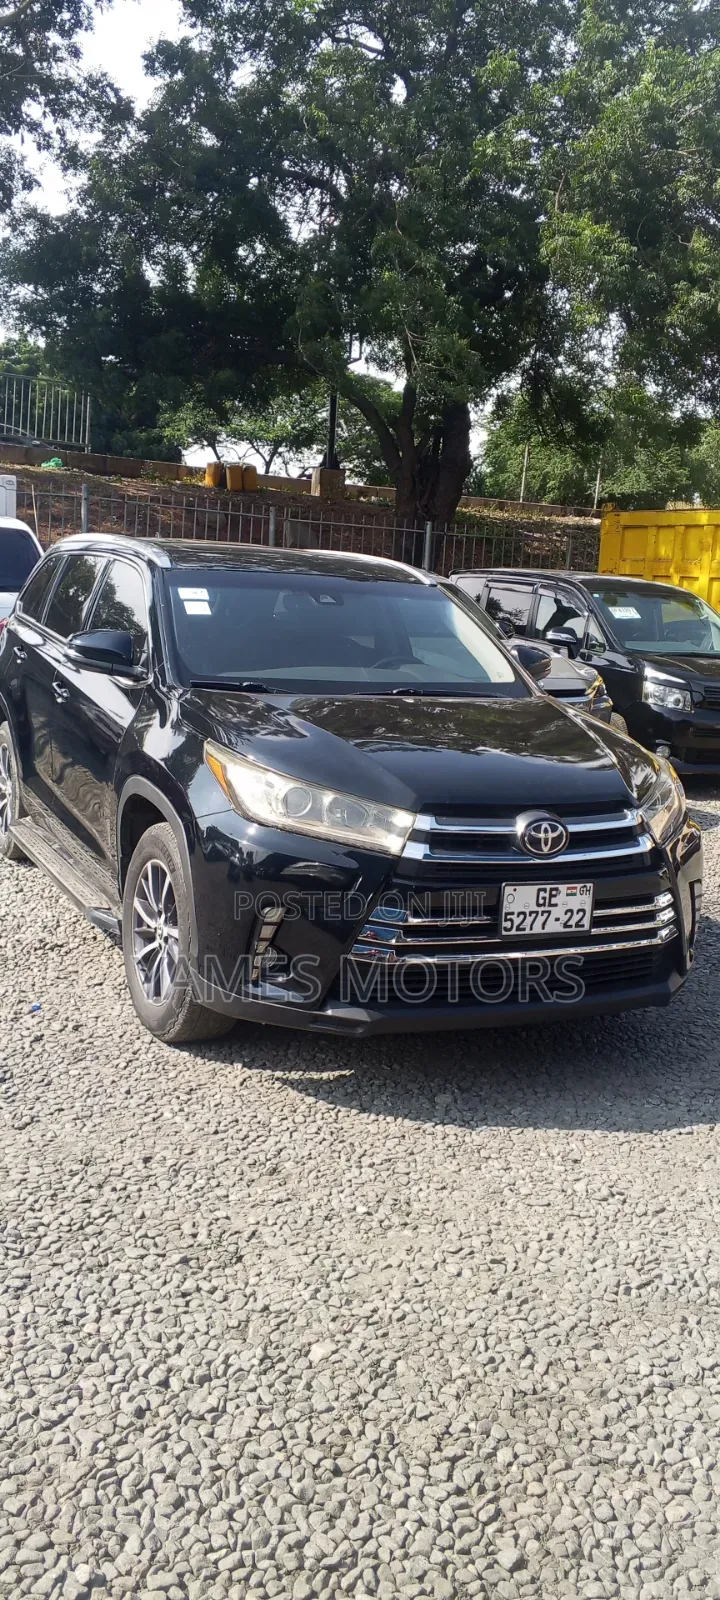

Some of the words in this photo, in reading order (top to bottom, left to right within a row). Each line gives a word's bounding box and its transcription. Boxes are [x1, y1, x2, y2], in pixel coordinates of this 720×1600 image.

[535, 887, 559, 908] GE
[579, 885, 592, 896] GH
[503, 909, 587, 932] 5277-22
